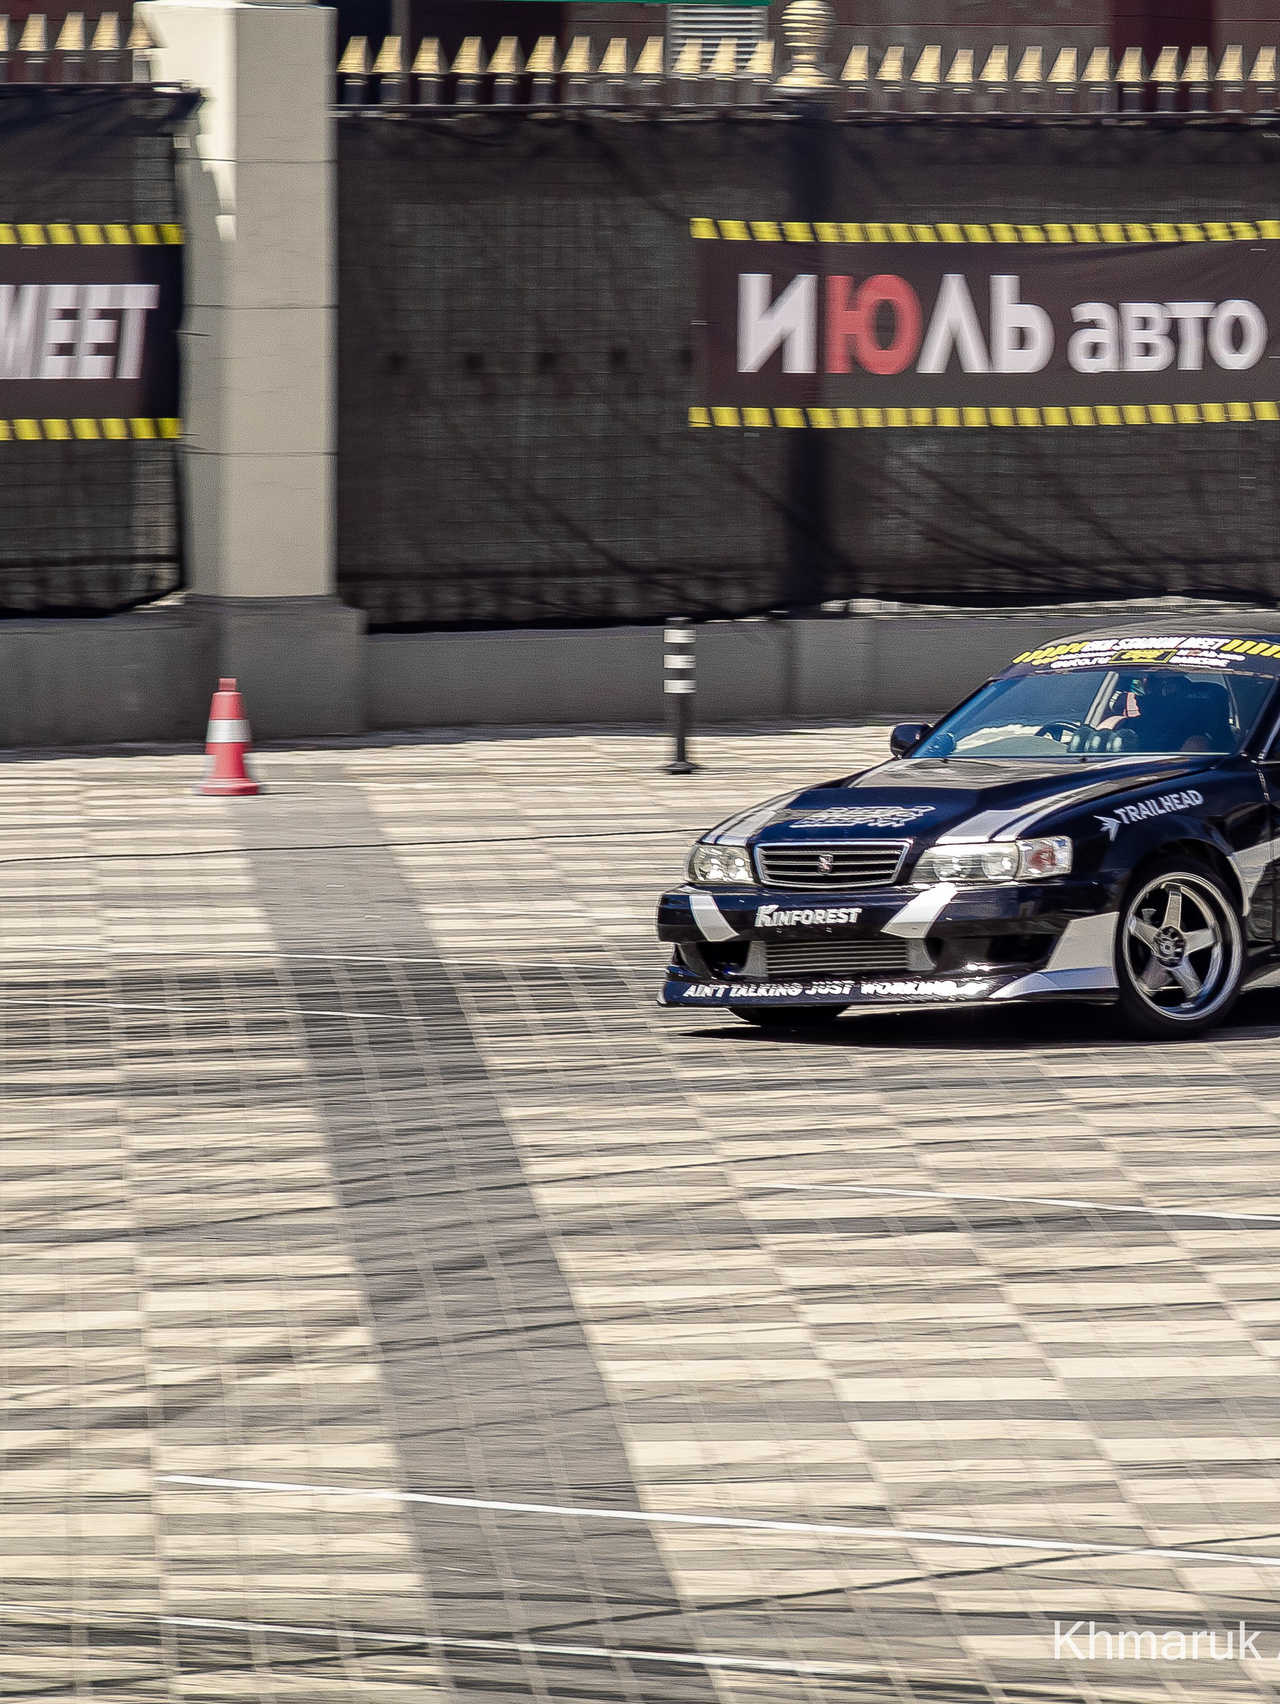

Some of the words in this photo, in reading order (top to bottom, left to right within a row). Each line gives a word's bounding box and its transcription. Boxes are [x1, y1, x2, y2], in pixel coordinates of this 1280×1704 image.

[737, 274, 1055, 373] ИЮЛЬ
[1067, 300, 1268, 372] авто
[1113, 789, 1204, 824] TRAILHEAD
[754, 904, 862, 927] KINFOREST
[729, 983, 803, 997] TALKING
[805, 980, 855, 995] JUST
